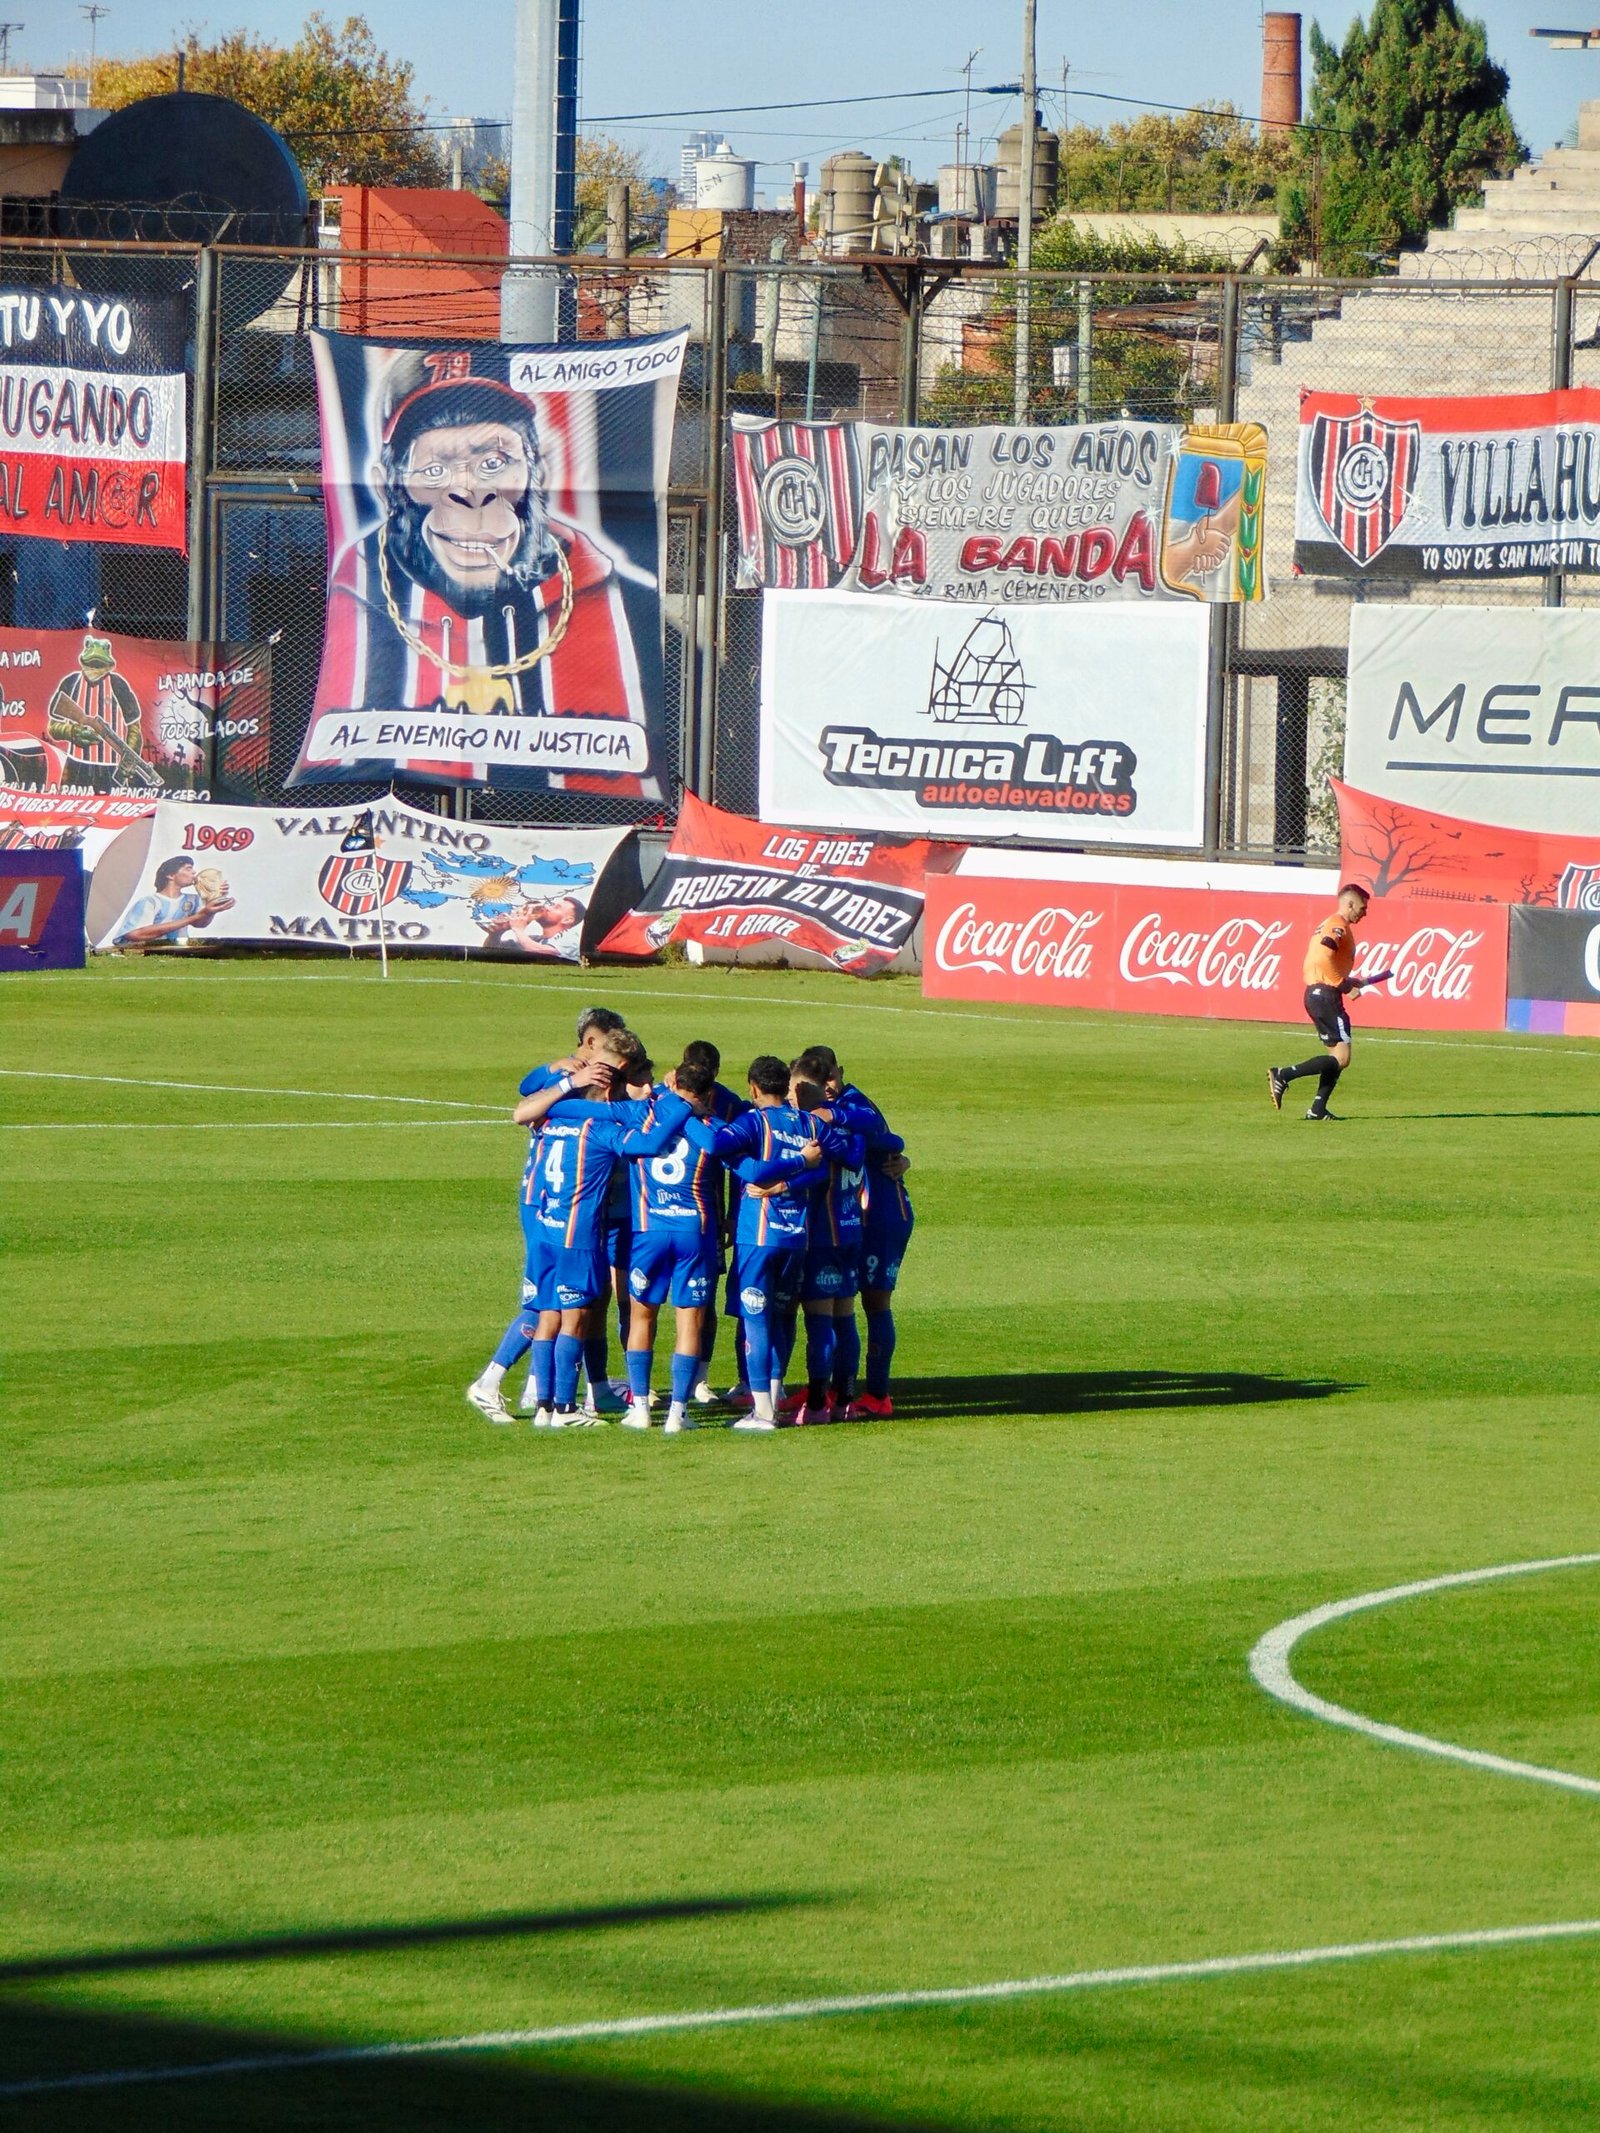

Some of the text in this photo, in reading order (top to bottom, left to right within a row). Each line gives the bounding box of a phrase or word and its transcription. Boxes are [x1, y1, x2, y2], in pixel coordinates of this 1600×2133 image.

[50, 297, 75, 335] Y
[81, 299, 132, 354] YO
[520, 345, 681, 383] AL AMIGO TODO
[0, 376, 153, 448] UGANDO
[867, 425, 1159, 493] PASAN LOS AÑOS
[897, 470, 1121, 504] Y LOS JUGADORES
[1441, 436, 1548, 530] VILLA
[897, 502, 1117, 531] SIEMPRE QUEDA
[859, 508, 1157, 593] LA BANDA
[1422, 547, 1440, 570] YO
[1443, 547, 1472, 570] SOY
[1474, 546, 1494, 570] DE
[1499, 545, 1528, 568] SAN
[1530, 542, 1583, 567] MARTIN
[944, 580, 988, 599] RANA
[1002, 580, 1106, 600] CEMENTERIO
[13, 650, 41, 668] VIDA
[159, 668, 254, 693] LA BANDA DE
[161, 718, 259, 740] TODOS LADOS
[330, 724, 631, 760] AL ENEMIGO NI JUSTICIA
[1023, 740, 1123, 786] Lift
[12, 796, 60, 812] PIBES
[55, 799, 83, 812] DE
[78, 800, 106, 813] LA
[61, 784, 95, 796] RANA
[110, 787, 159, 799] MENCHO
[161, 788, 172, 799] Y
[923, 783, 1133, 812] autoelevadores
[182, 823, 255, 852] 1969
[274, 809, 491, 851] VALNTINO
[762, 835, 875, 867] LOS PIBES
[794, 863, 820, 879] DE
[663, 874, 912, 943] AGUSTIN ALVAREZ
[704, 913, 802, 938] LA RANA
[269, 914, 431, 941] MATEO
[935, 902, 1105, 980] Coca-Cola
[1119, 912, 1294, 991] Coca-Cola
[1348, 927, 1486, 1001] ca-Cola
[545, 1140, 565, 1193] 4
[651, 1137, 690, 1185] 8
[866, 1255, 879, 1273] 9
